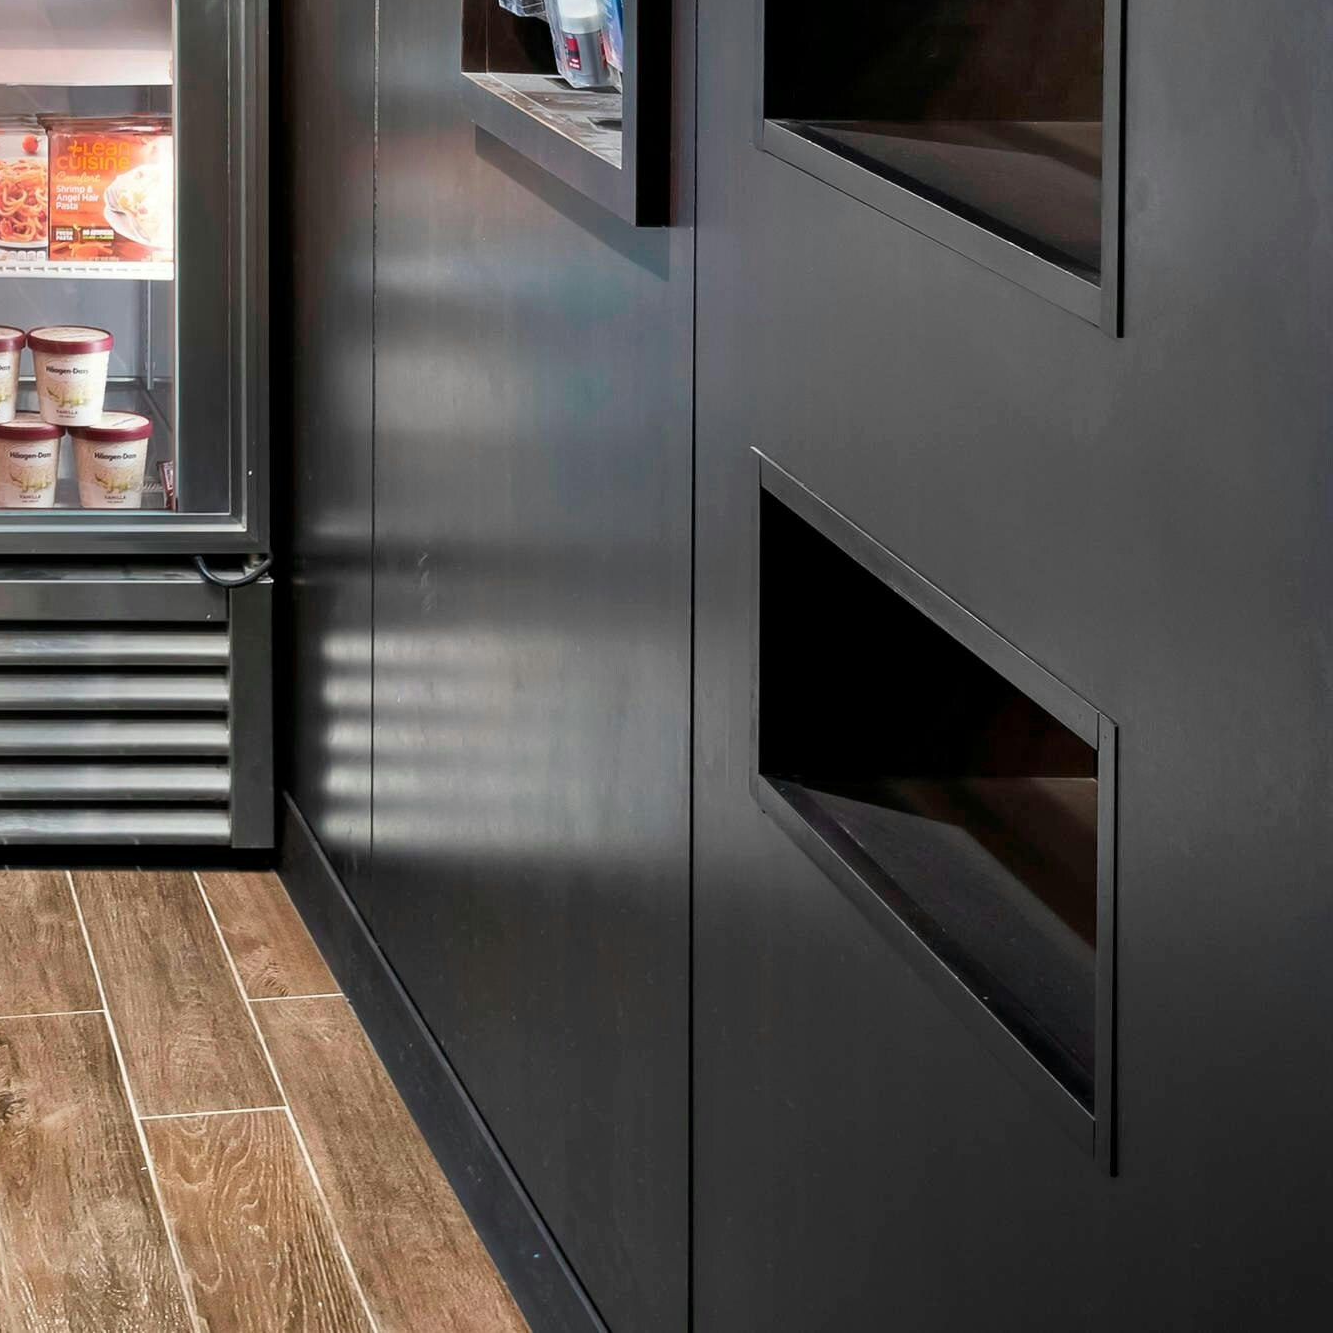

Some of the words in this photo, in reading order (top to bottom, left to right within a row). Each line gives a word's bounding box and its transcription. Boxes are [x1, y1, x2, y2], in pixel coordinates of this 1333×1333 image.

[55, 170, 101, 184] Comfort
[56, 185, 86, 195] Shrimp
[56, 194, 81, 203] Angel
[82, 194, 99, 202] Hair
[55, 202, 79, 210] Pasta
